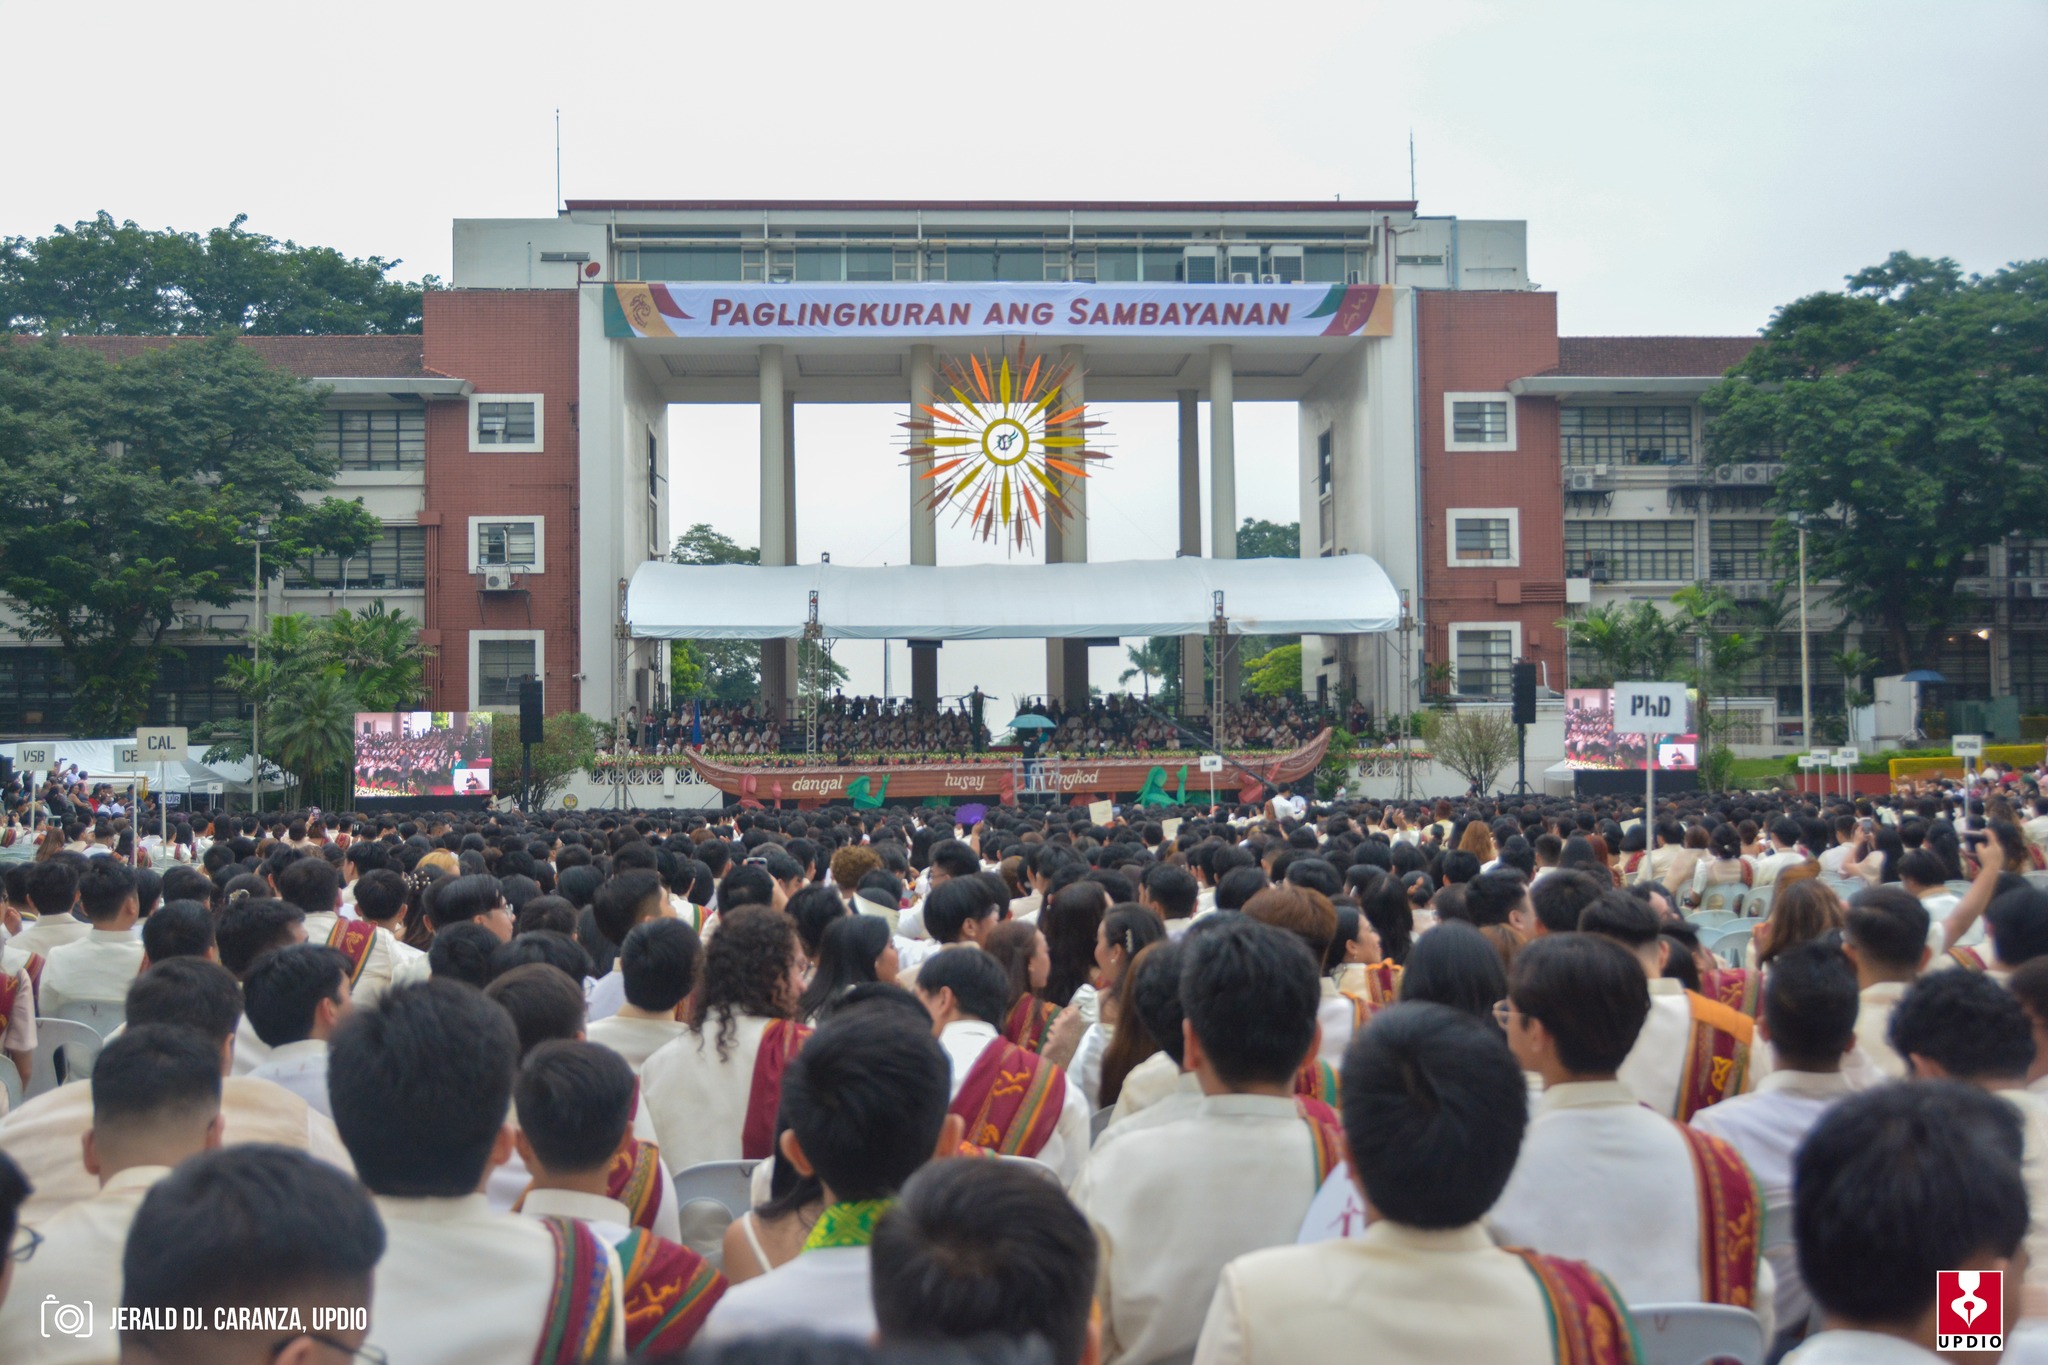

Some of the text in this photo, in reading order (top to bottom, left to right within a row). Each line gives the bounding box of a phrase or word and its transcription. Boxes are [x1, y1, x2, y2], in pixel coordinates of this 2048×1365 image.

[710, 298, 1290, 327] PAGLINGKURAN ANG SAMBAYANAN
[1631, 694, 1671, 717] PhD
[147, 735, 177, 750] CAL
[23, 750, 45, 763] VSB
[122, 750, 138, 763] CE
[792, 774, 843, 795] dangal
[944, 772, 986, 791] husay
